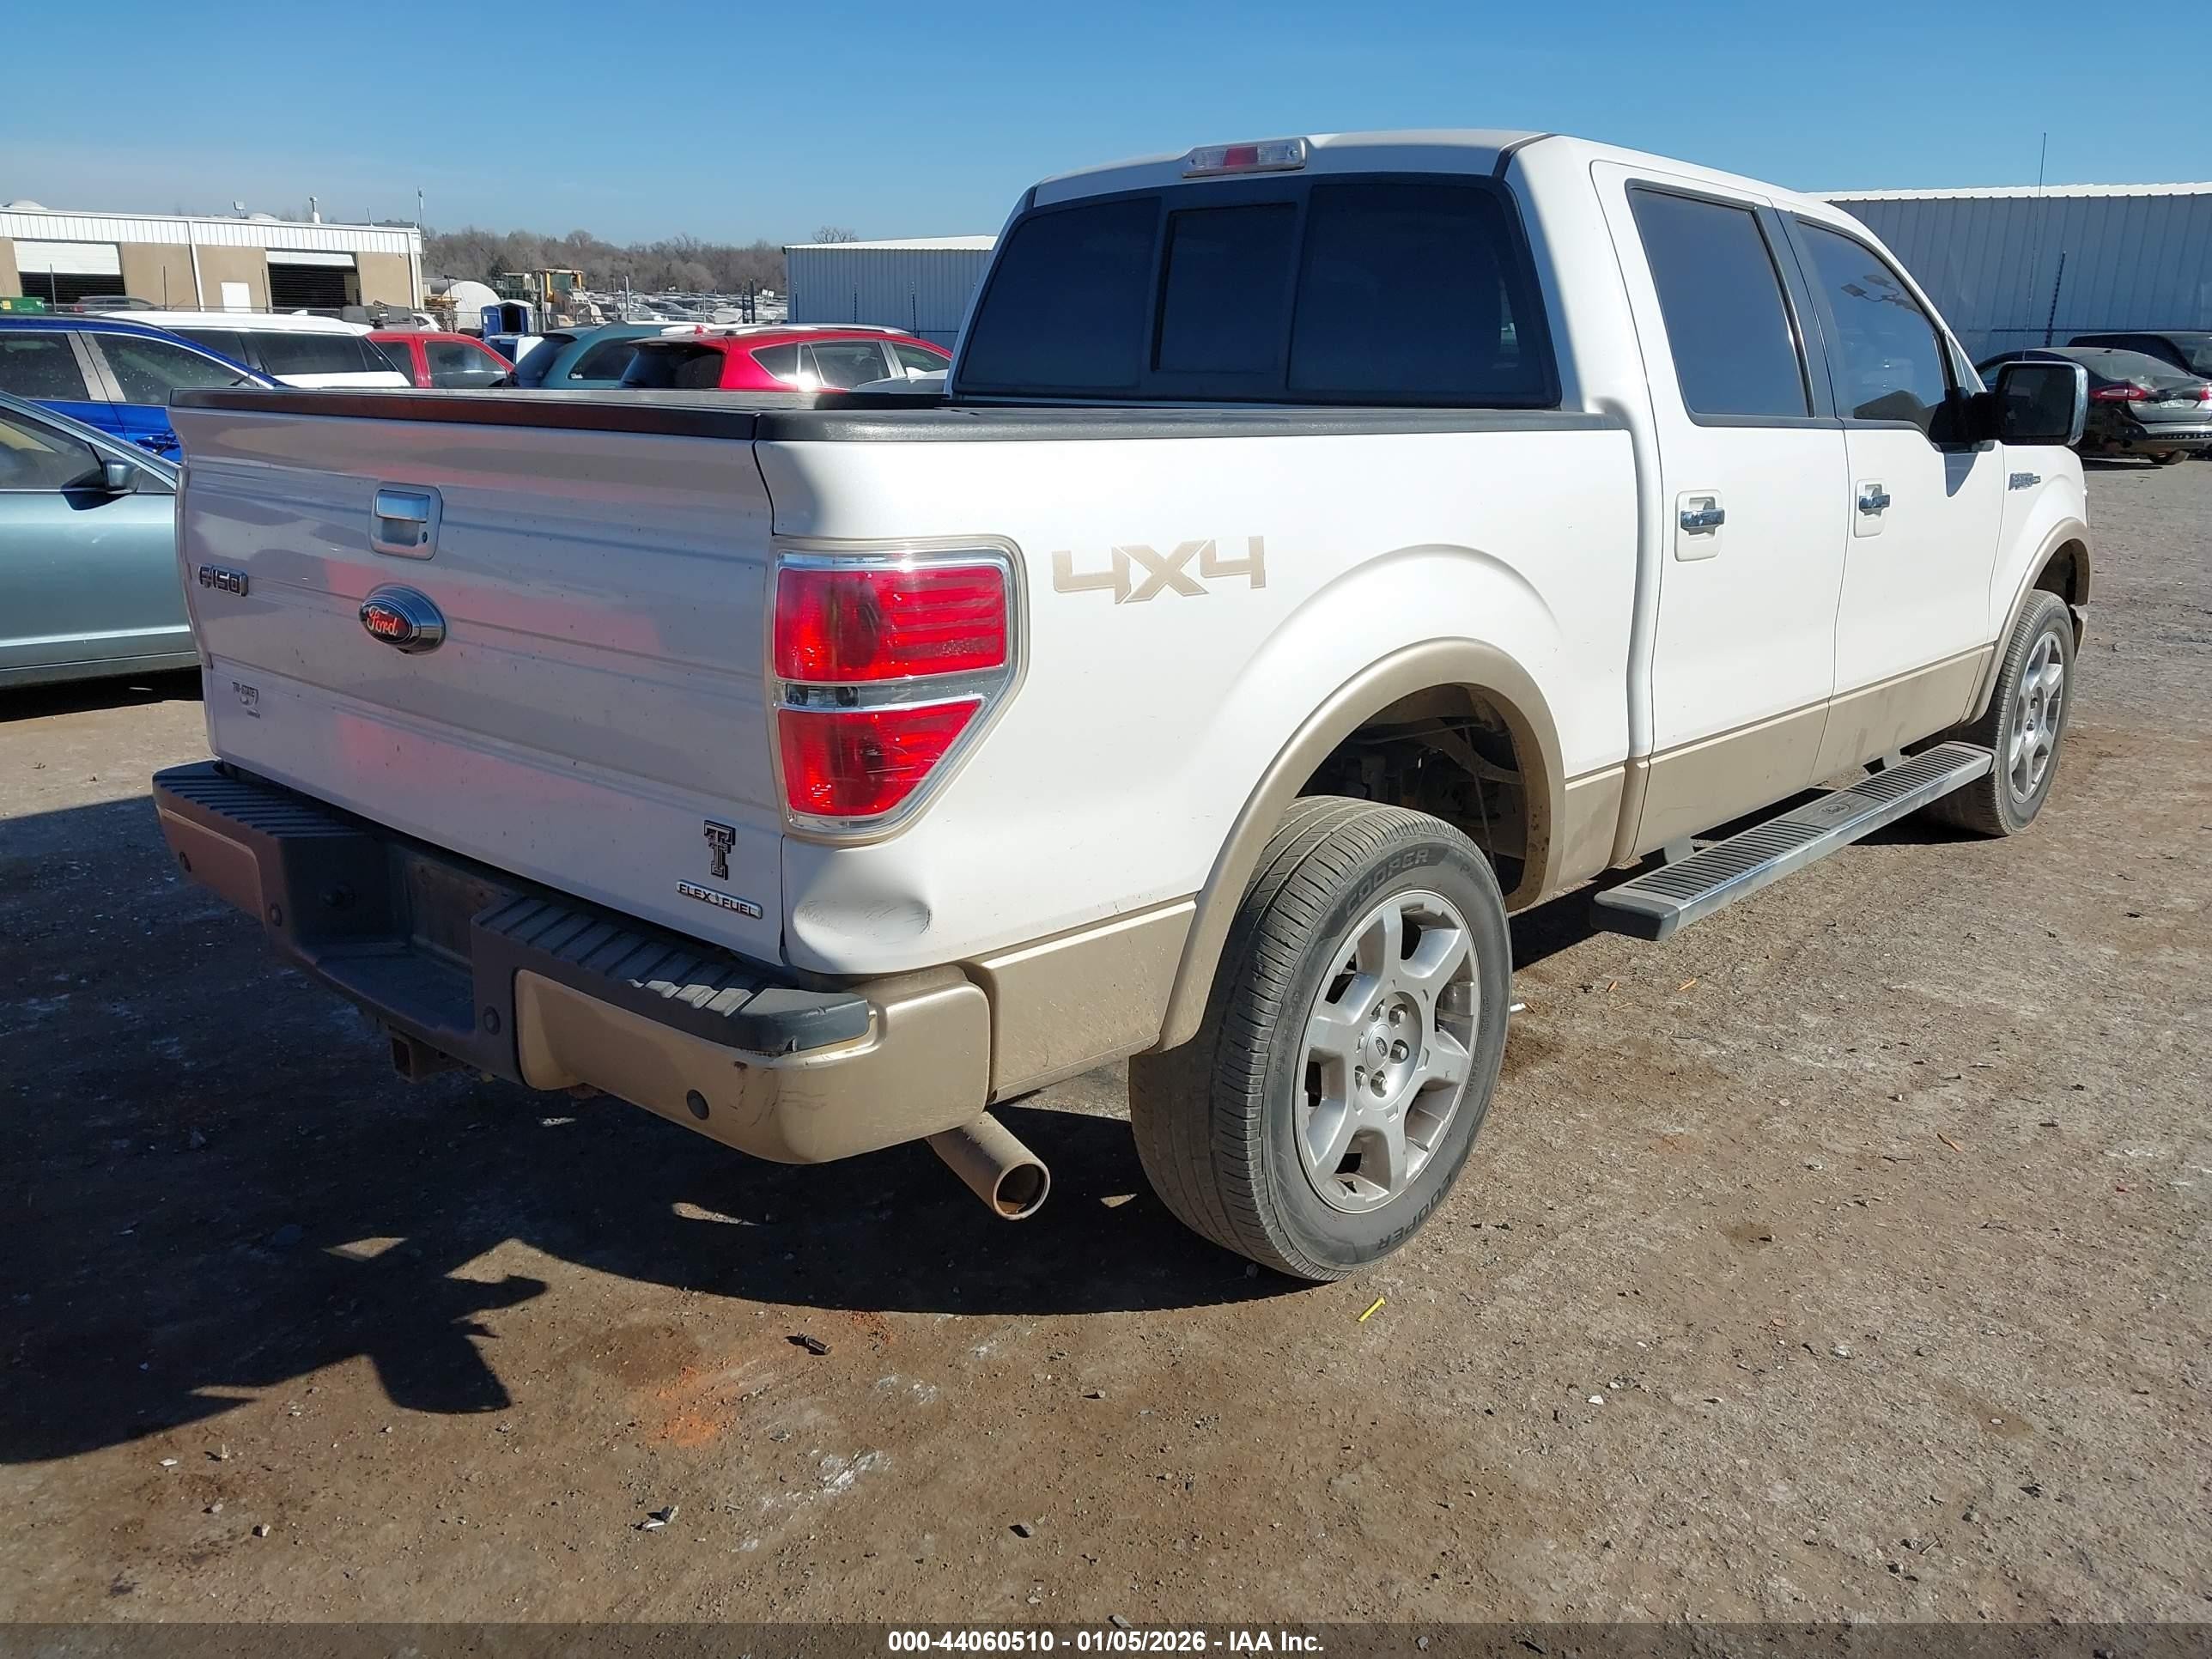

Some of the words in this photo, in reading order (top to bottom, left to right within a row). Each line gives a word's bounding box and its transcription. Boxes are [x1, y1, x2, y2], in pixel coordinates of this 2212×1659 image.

[1051, 535, 1267, 605] 4X4
[366, 605, 398, 636] Ford
[678, 883, 712, 904] FLEX
[721, 897, 760, 918] FUEL
[1346, 848, 1430, 917] COOPER
